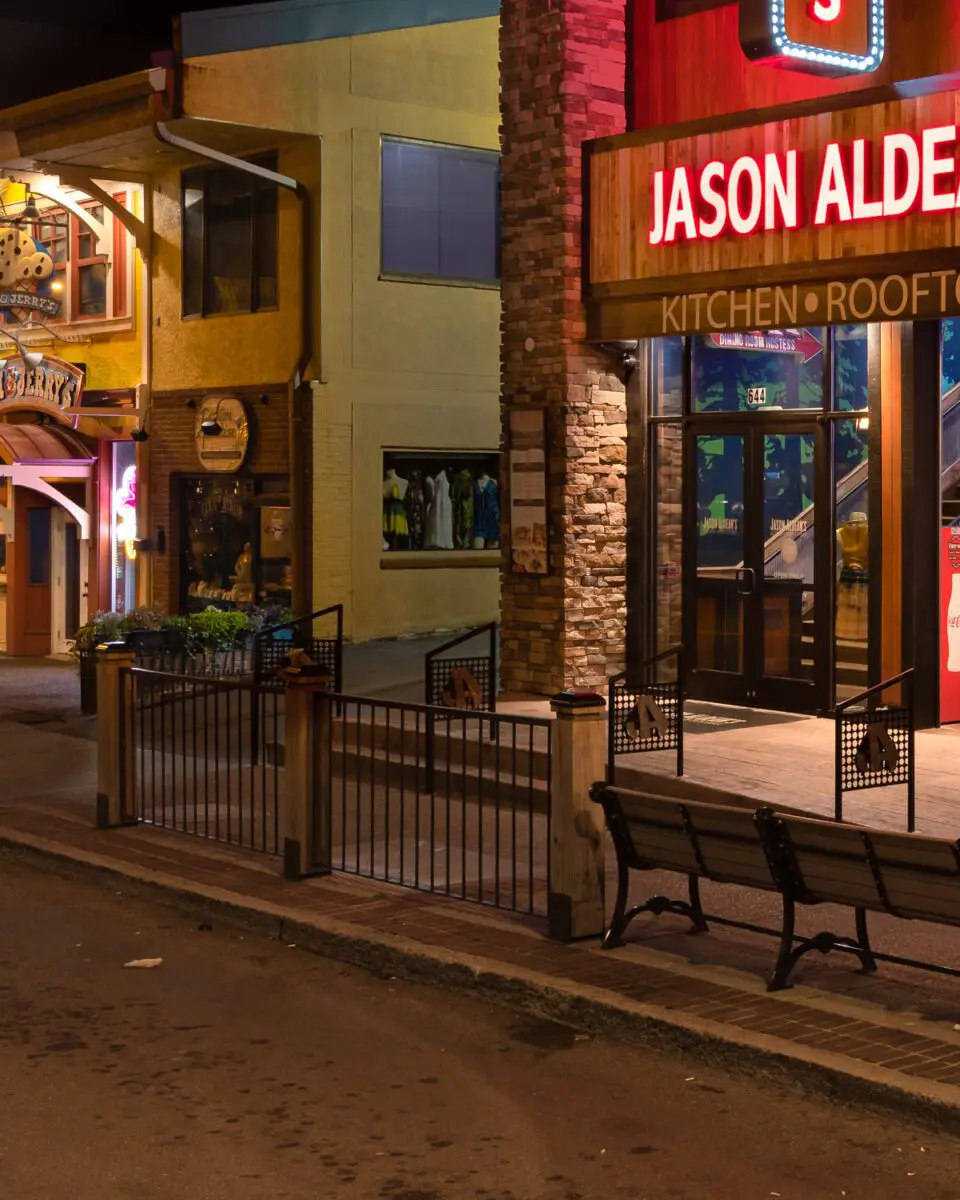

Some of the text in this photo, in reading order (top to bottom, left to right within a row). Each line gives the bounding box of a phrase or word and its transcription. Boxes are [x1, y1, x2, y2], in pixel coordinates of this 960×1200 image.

[648, 149, 797, 245] JASON
[10, 294, 56, 311] JERRY'S
[661, 284, 799, 334] KITCHEN
[719, 334, 796, 351] DINING ROOM HOSTESS
[747, 389, 766, 404] 644
